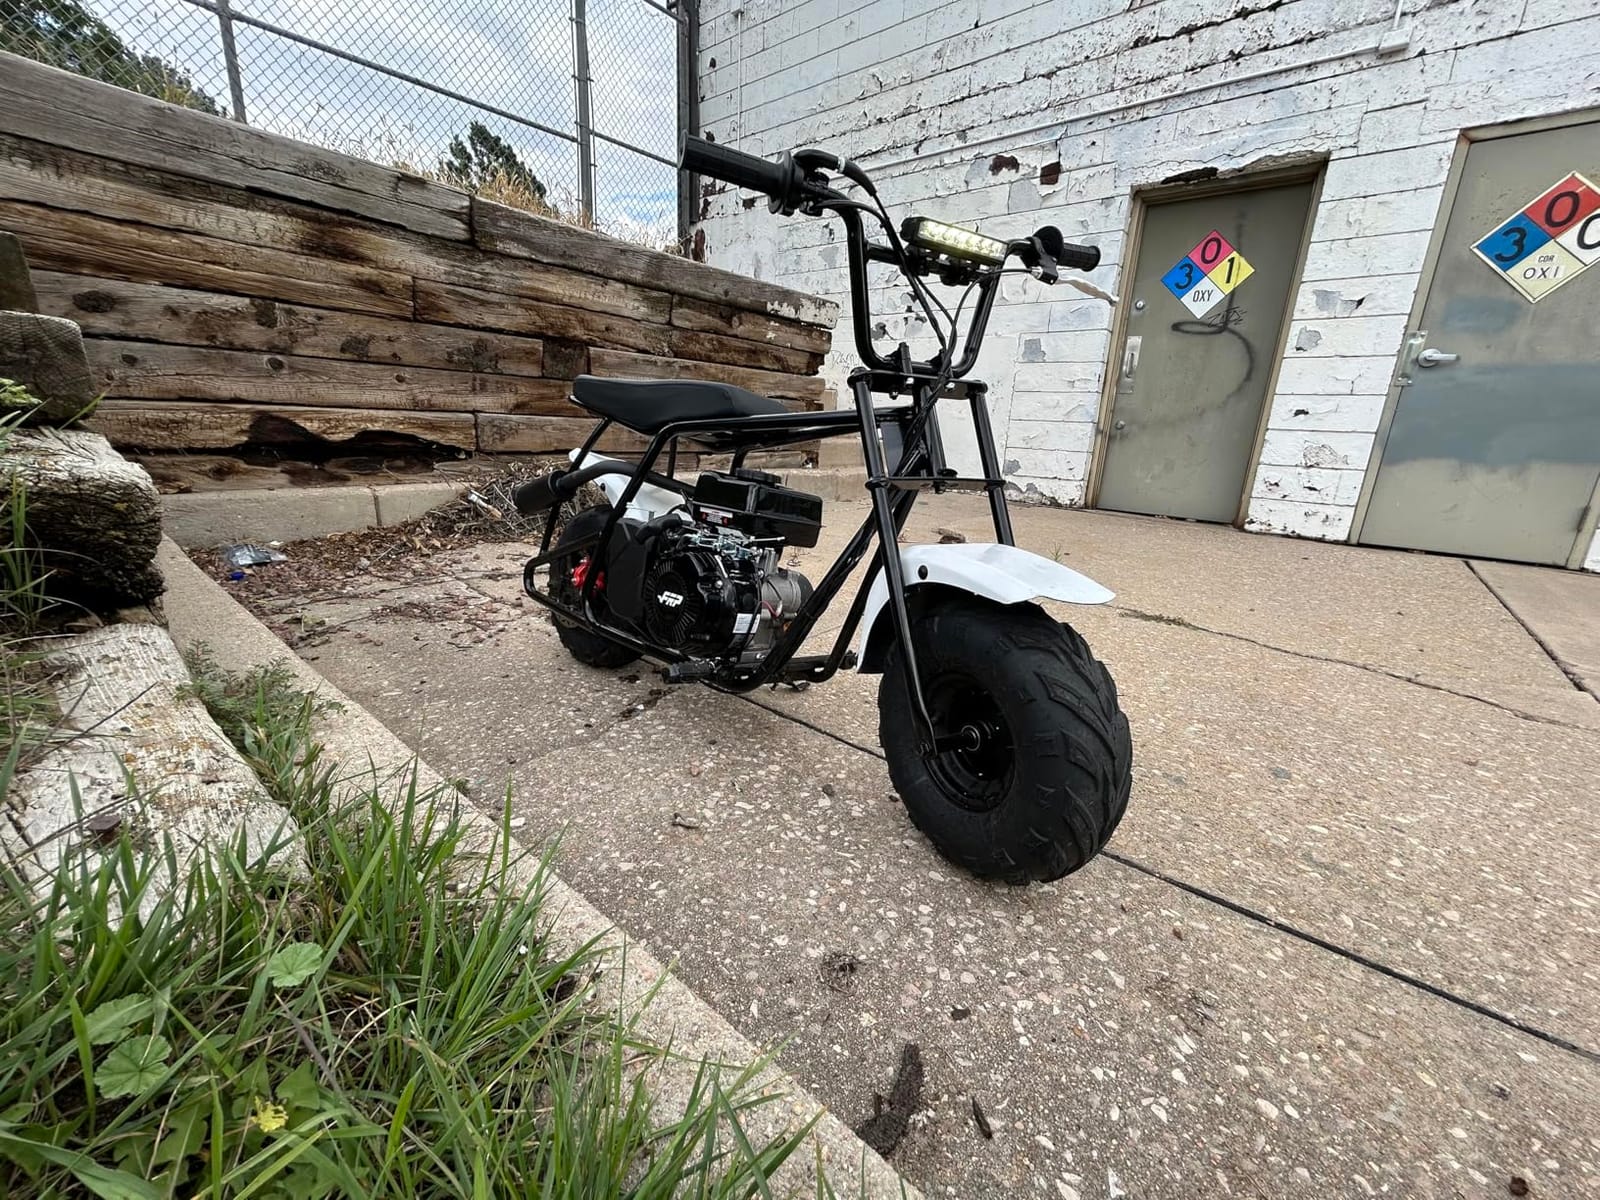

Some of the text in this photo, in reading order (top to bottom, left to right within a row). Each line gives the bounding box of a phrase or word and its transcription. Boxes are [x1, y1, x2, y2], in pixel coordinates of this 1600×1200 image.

[1544, 190, 1580, 228] 0
[1200, 237, 1222, 265] 0
[1494, 227, 1527, 262] 3
[1174, 263, 1194, 290] 3
[1225, 256, 1236, 284] 1
[1192, 289, 1213, 303] OXY
